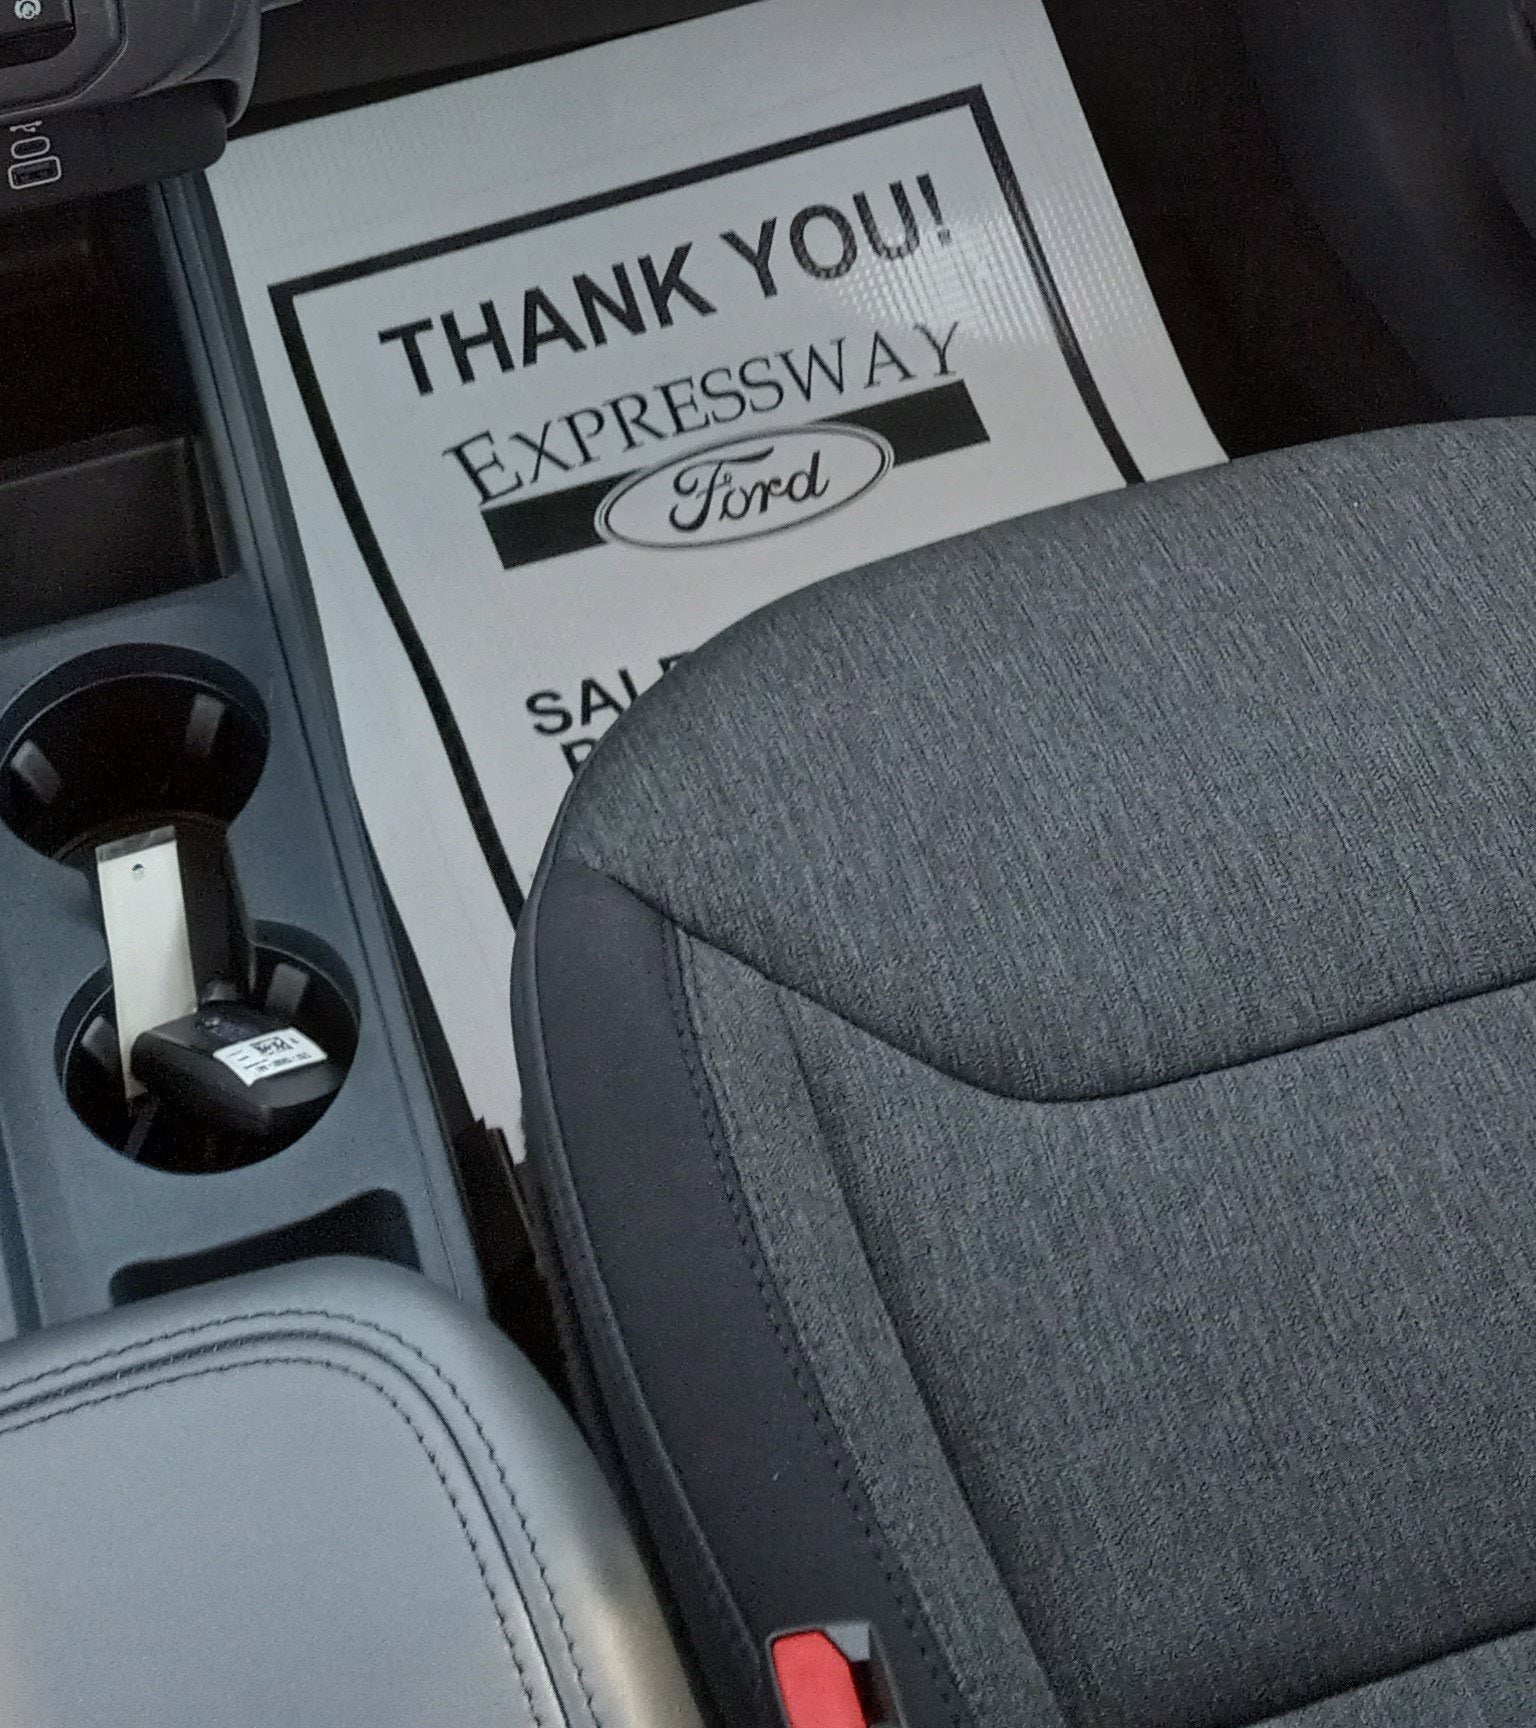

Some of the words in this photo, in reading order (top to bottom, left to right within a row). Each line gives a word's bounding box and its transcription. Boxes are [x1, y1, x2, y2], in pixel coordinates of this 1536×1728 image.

[379, 241, 718, 397] THANK
[720, 174, 955, 299] YOU!
[444, 320, 961, 506] EXPRESSWAY
[667, 446, 831, 534] Ford
